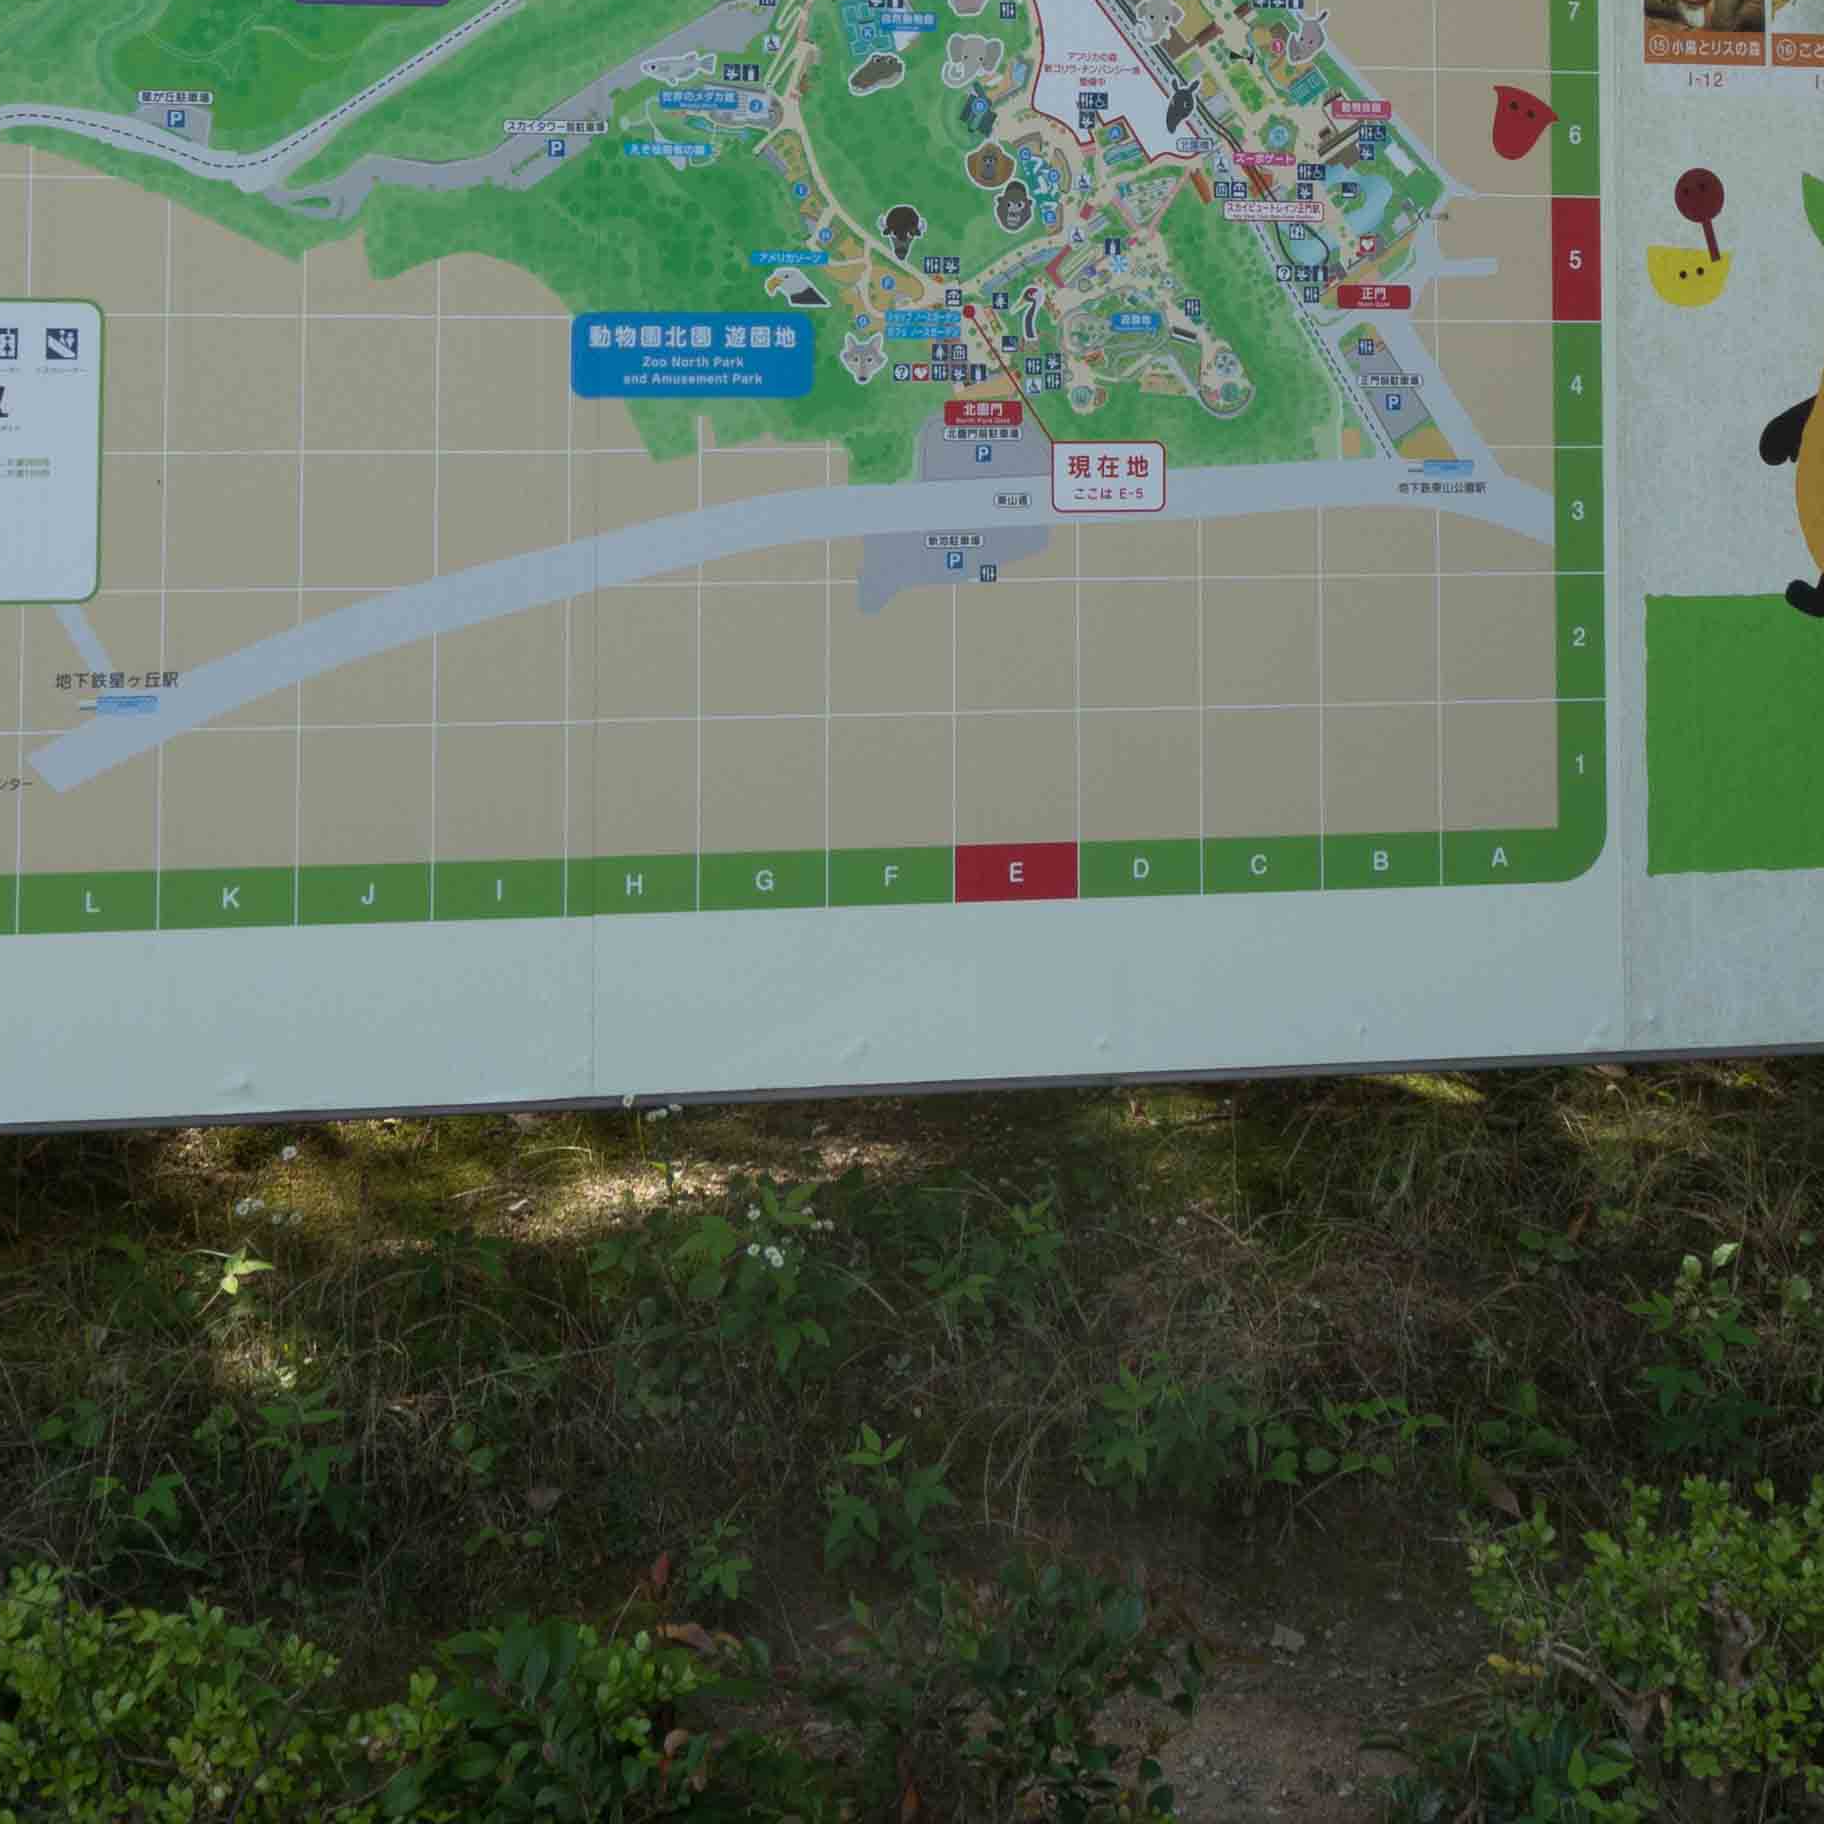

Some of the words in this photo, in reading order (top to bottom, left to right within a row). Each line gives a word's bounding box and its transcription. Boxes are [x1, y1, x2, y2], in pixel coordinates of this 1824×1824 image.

[1567, 2, 1579, 20] 7
[1569, 125, 1582, 146] 6
[1569, 250, 1582, 269] 5
[1360, 287, 1386, 300] 正門
[589, 325, 711, 348] 動物園北園
[725, 325, 796, 348] 遊園地
[642, 356, 668, 368] Zoo
[672, 356, 709, 368] North
[713, 356, 744, 368] Park
[624, 373, 647, 384] and
[652, 373, 728, 385] Amusement
[732, 373, 762, 384] Park
[1569, 376, 1583, 395] 4
[1068, 454, 1149, 479] 現在地
[1074, 487, 1112, 500] ここは
[1119, 487, 1144, 500] E-5
[1571, 501, 1584, 520] 3
[1572, 627, 1586, 649] 2
[1576, 754, 1584, 774] 1
[1250, 855, 1267, 875] C
[1373, 851, 1389, 871] B
[1491, 848, 1509, 867] A
[885, 866, 899, 886] F
[1009, 862, 1024, 882] E
[1133, 857, 1149, 879] D
[496, 880, 502, 901] I
[626, 874, 643, 896] H
[755, 870, 774, 891] G
[85, 891, 100, 913] L
[223, 887, 240, 909] K
[361, 884, 375, 905] J
